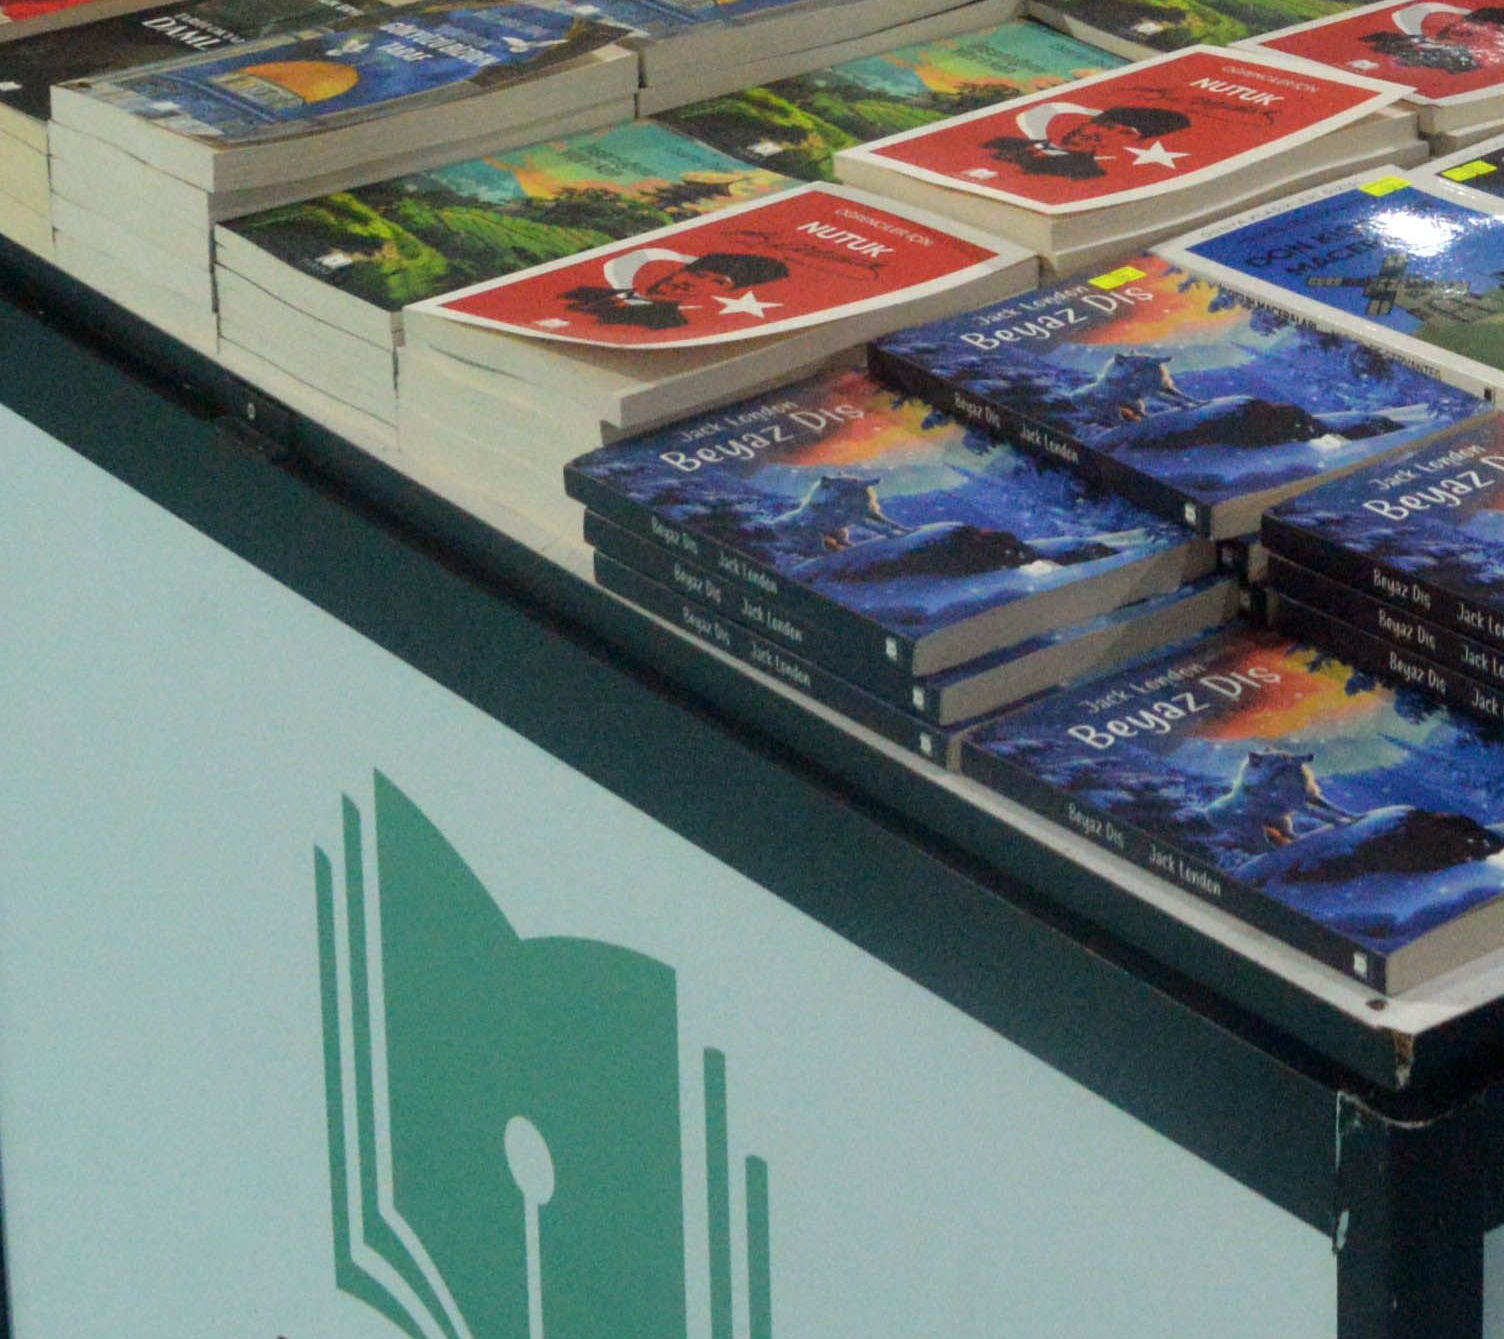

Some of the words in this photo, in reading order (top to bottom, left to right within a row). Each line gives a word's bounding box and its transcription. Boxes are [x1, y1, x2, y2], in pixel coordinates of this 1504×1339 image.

[141, 15, 227, 52] DAML
[797, 220, 896, 259] NUTUK
[960, 303, 1088, 355] Beyaz
[659, 422, 795, 473] Beyaz
[1369, 468, 1417, 492] Jack
[1416, 443, 1487, 475] London
[1362, 470, 1496, 522] Beyaz
[1372, 567, 1409, 602] Beyaz
[1456, 601, 1485, 630] Jack
[1378, 608, 1413, 642] Beyaz
[1460, 643, 1488, 672] Jack
[1079, 689, 1133, 715] Jack
[1130, 662, 1207, 695] London
[1389, 650, 1426, 684] Beyaz
[1470, 686, 1500, 716] Jack
[1067, 691, 1211, 751] Beyaz
[1067, 802, 1104, 836] Beyaz
[1148, 842, 1175, 871] Jack
[1177, 859, 1222, 898] London
